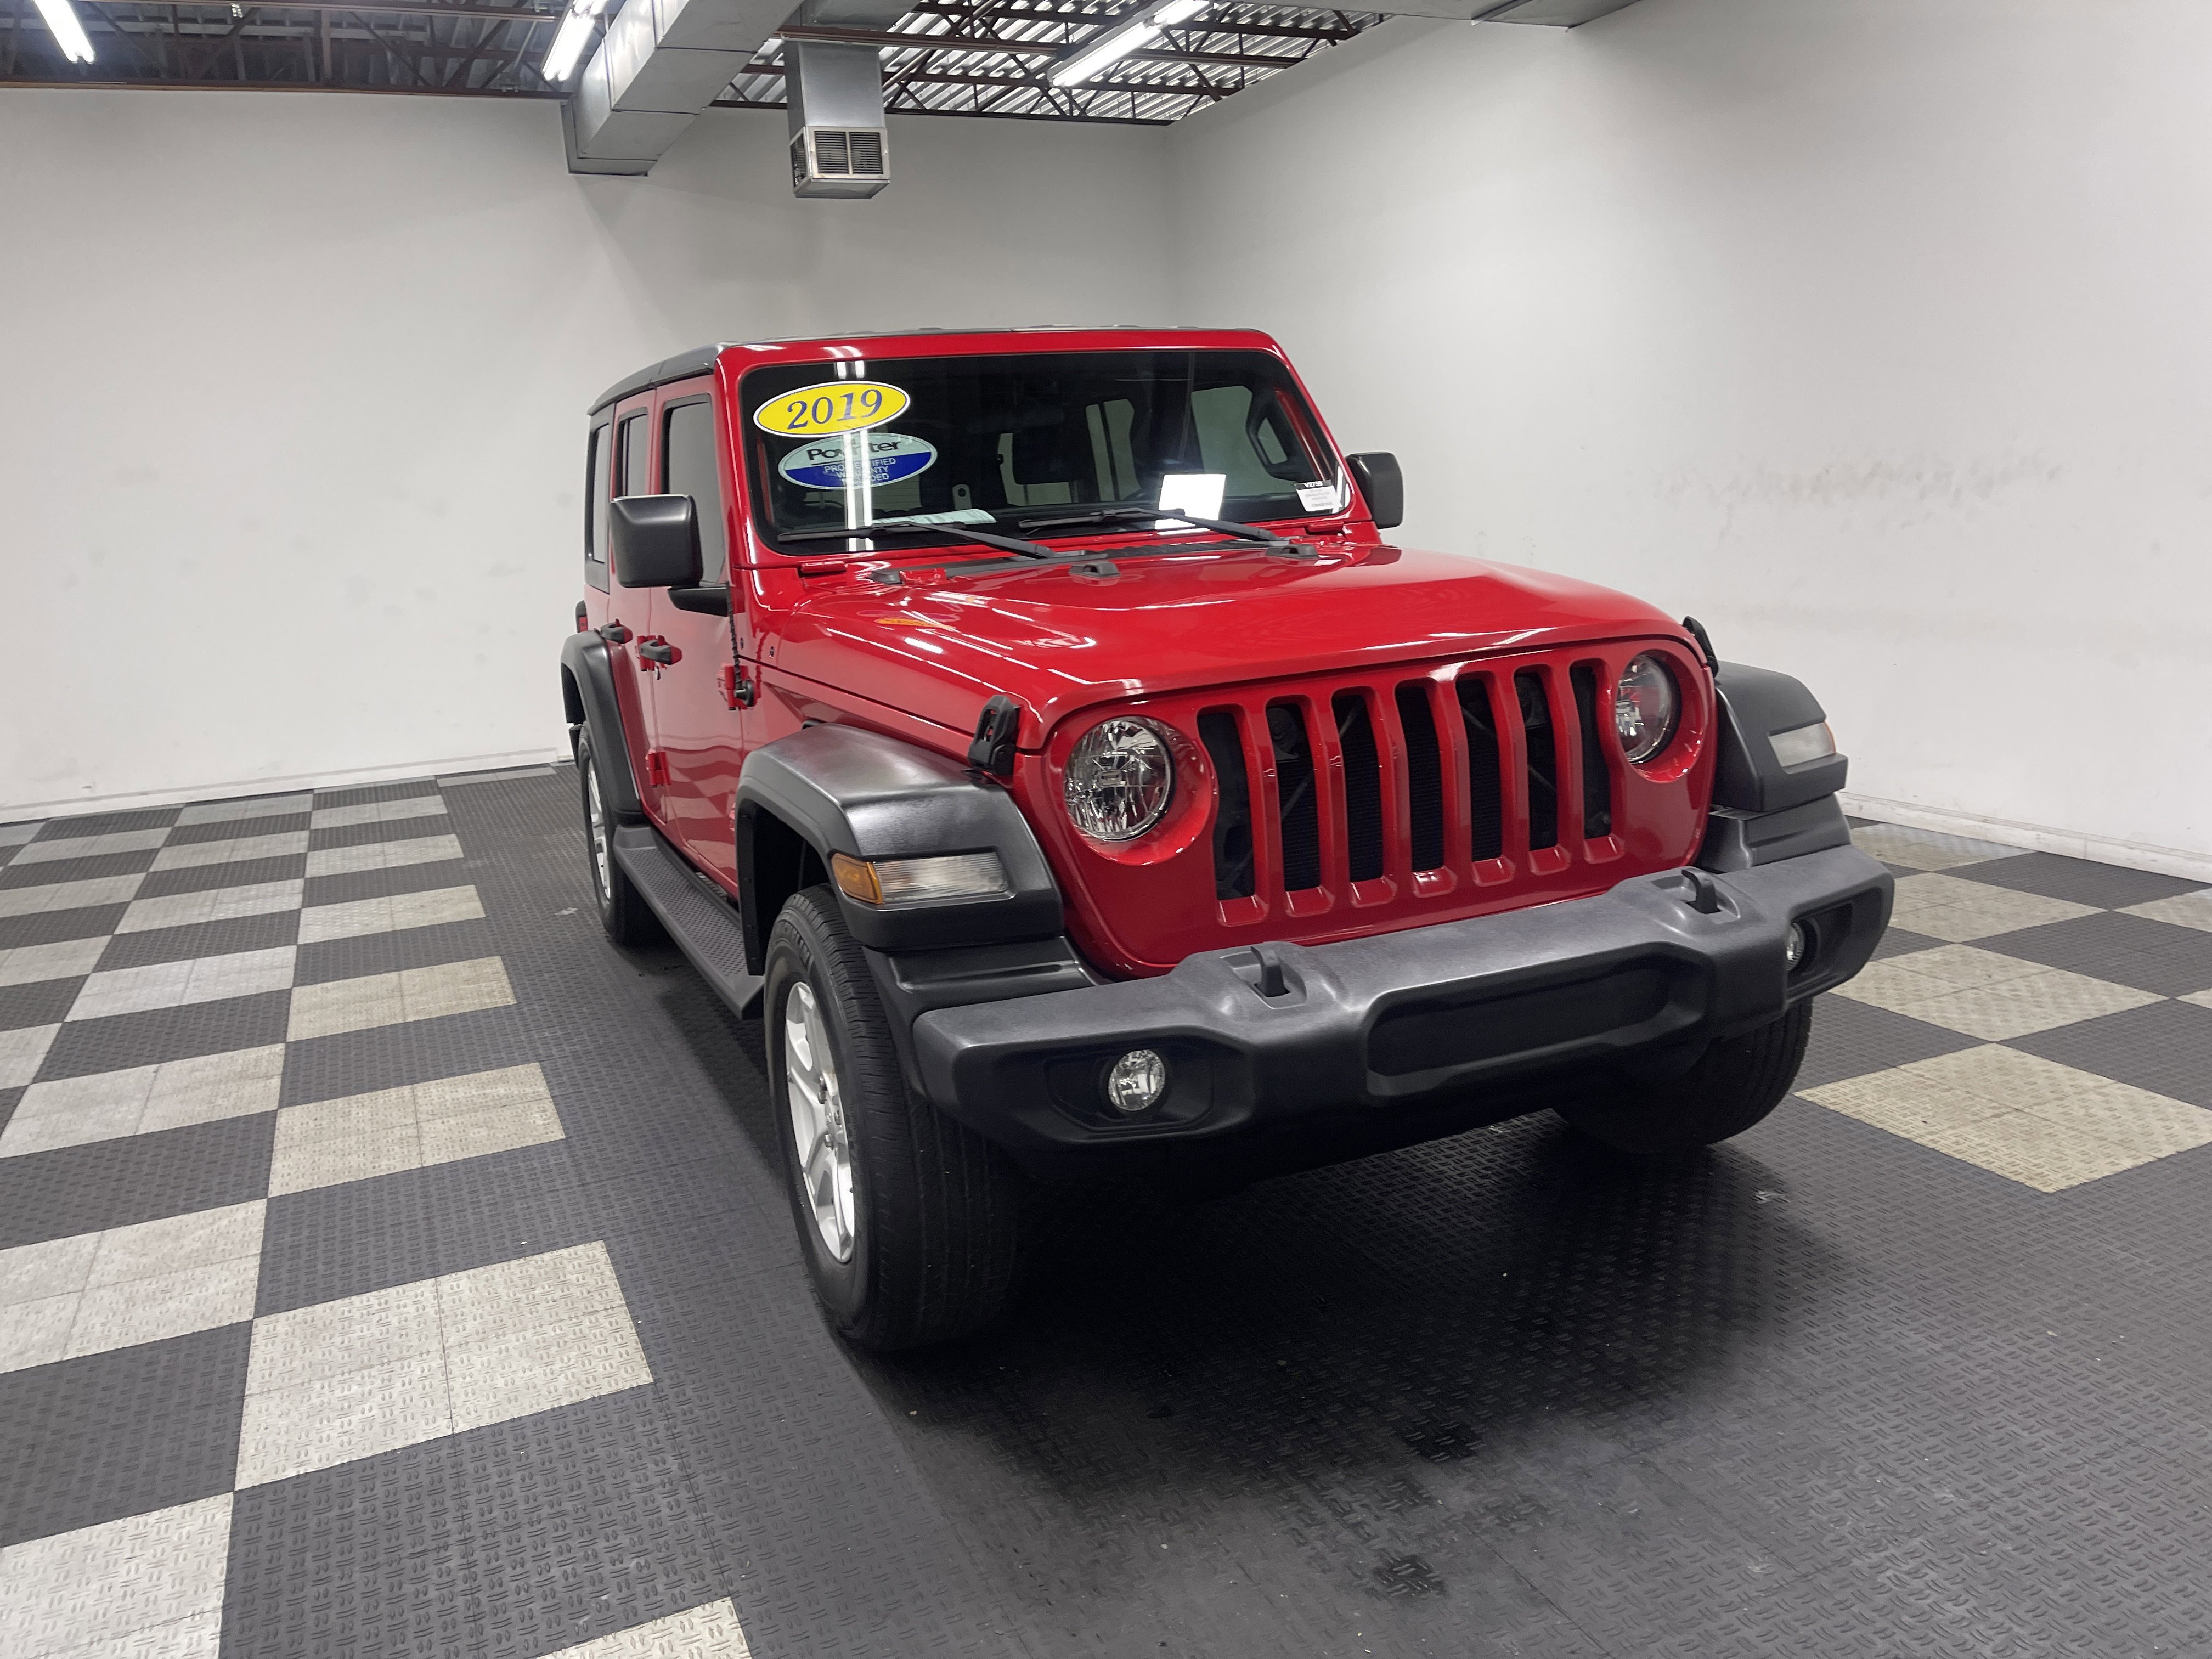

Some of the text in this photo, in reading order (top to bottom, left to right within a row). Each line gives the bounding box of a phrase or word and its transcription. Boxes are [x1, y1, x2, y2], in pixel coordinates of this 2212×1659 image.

[787, 389, 883, 430] 2019
[848, 458, 896, 472] EIFIED
[836, 466, 888, 479] WRNTY
